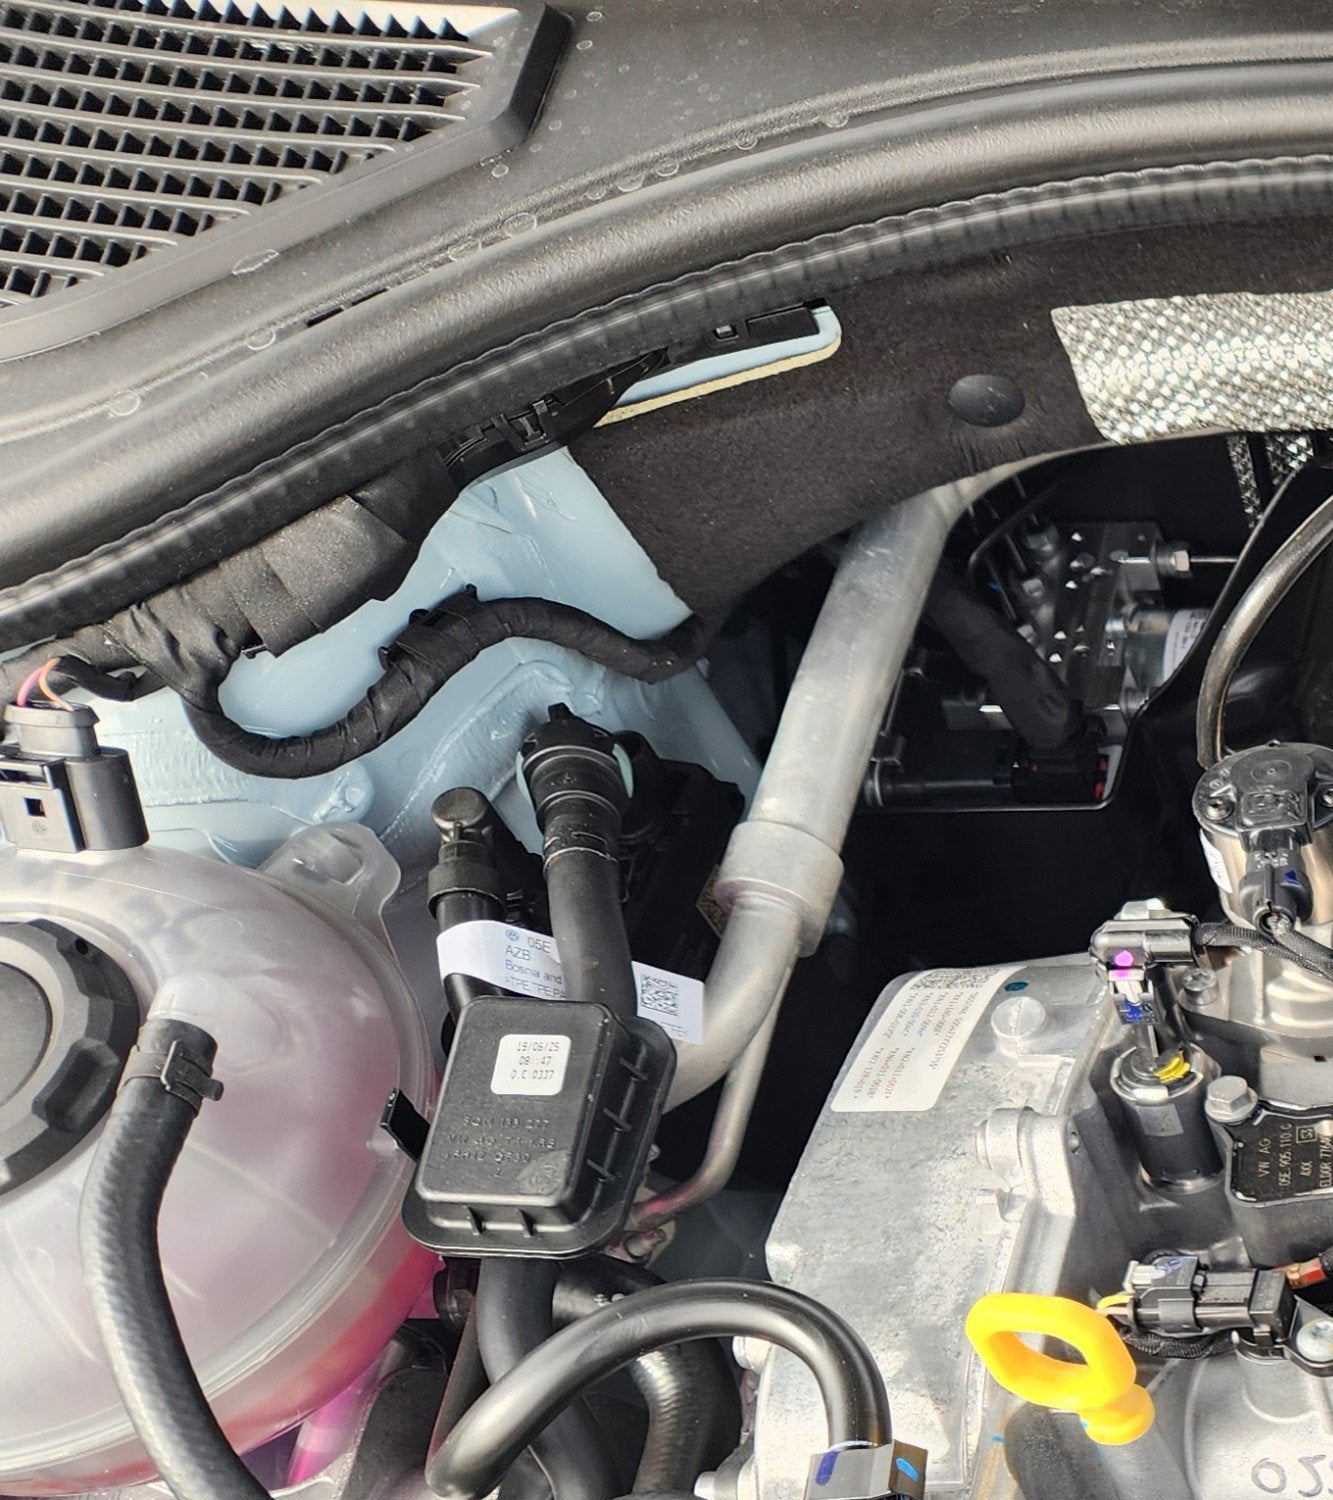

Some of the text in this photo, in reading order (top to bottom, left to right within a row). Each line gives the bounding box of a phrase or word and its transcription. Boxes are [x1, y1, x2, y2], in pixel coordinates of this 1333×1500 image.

[526, 936, 552, 954] 05E
[1258, 1138, 1271, 1178] VW AG
